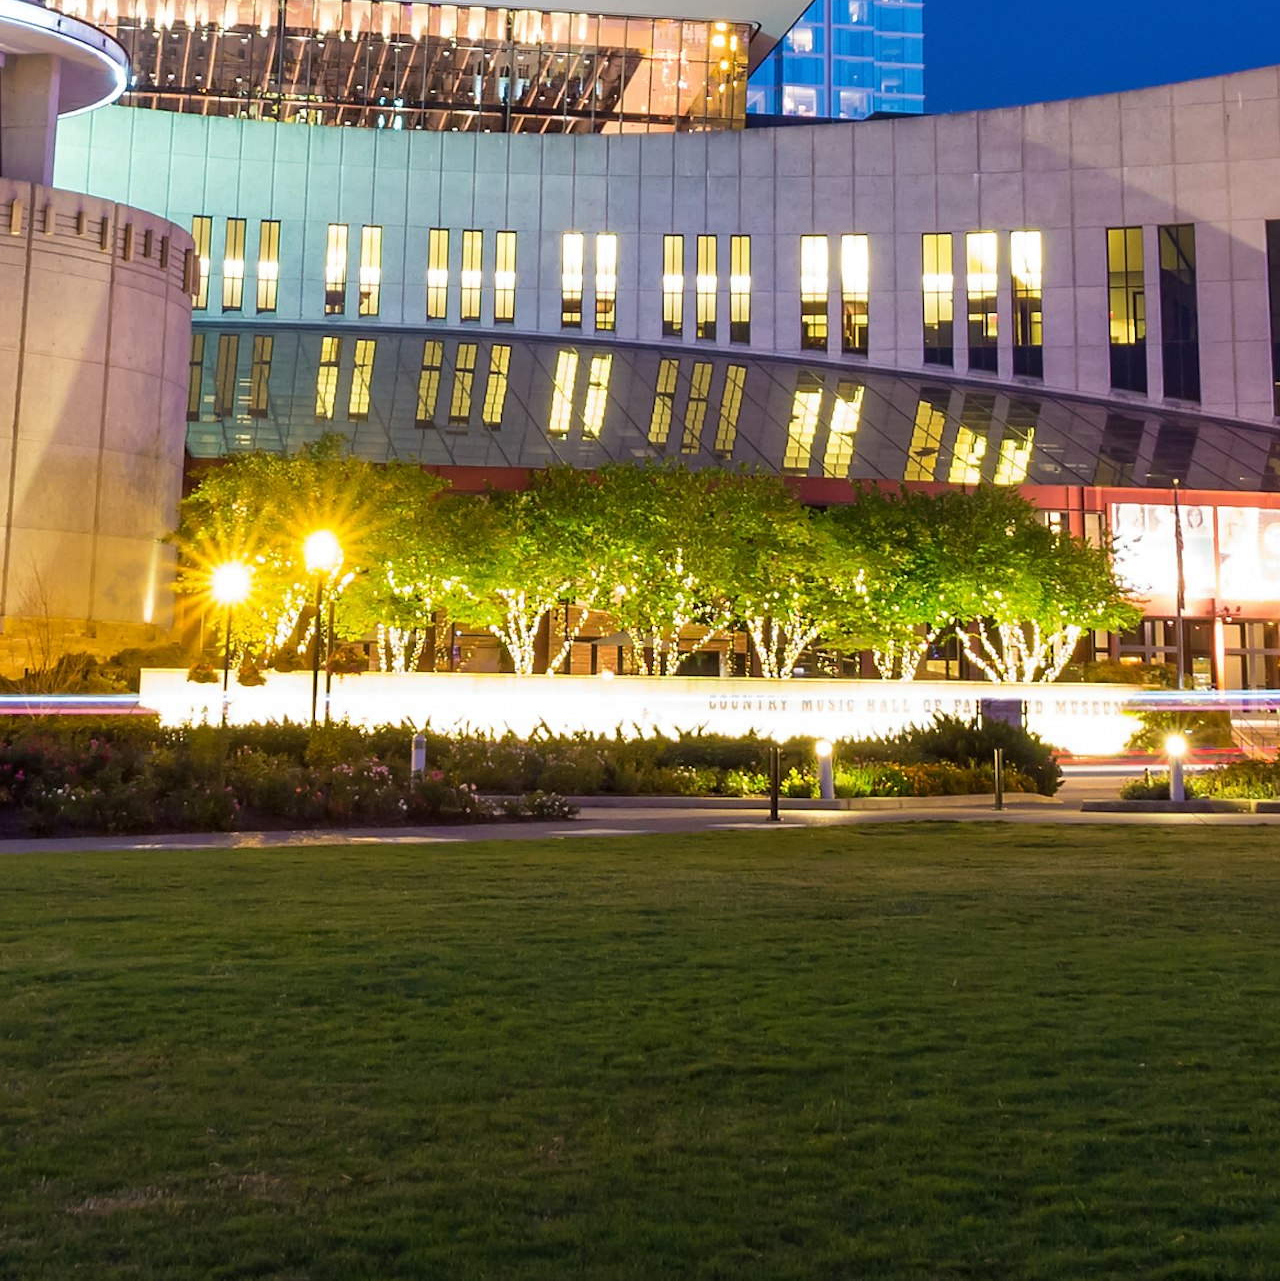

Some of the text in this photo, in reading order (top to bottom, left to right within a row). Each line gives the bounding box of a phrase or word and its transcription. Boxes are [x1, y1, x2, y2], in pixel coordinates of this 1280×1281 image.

[708, 694, 788, 710] COUNTRY
[801, 698, 855, 712] MUSIC
[866, 698, 911, 714] HALL
[1055, 700, 1123, 716] MUSEUM
